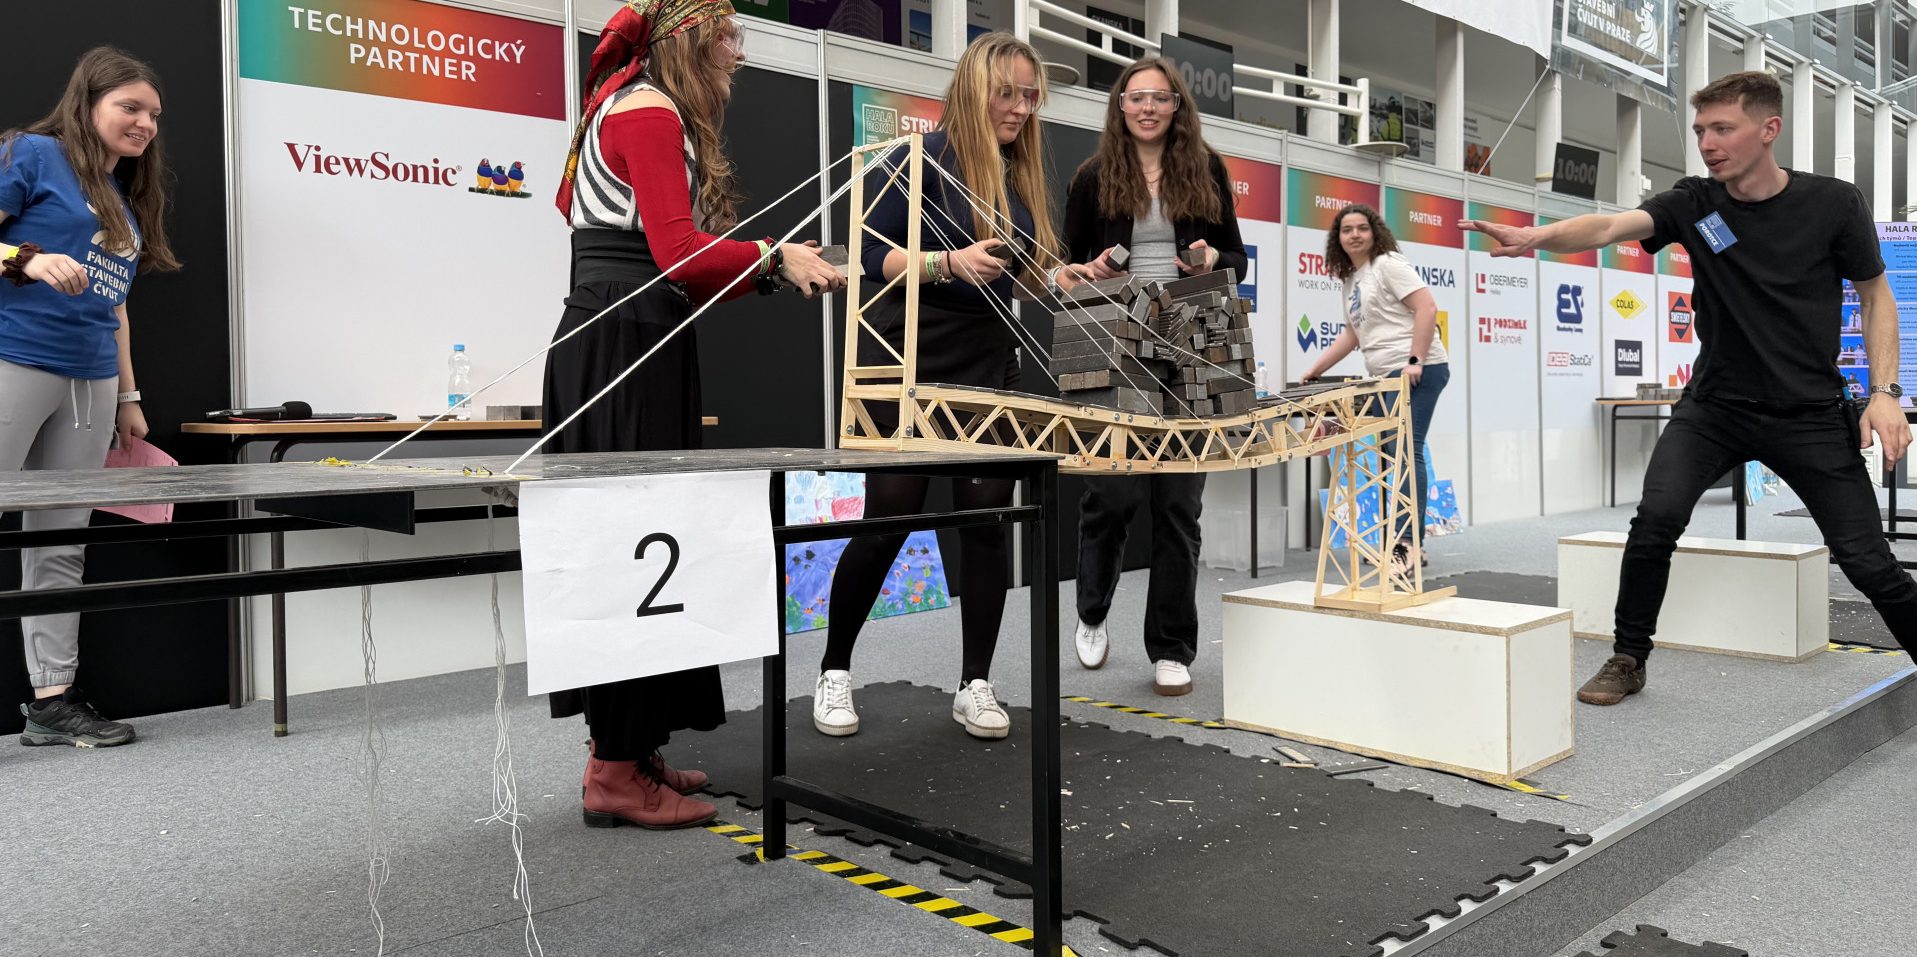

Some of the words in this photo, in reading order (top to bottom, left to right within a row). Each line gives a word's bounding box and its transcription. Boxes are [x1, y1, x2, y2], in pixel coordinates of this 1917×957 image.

[1577, 0, 1616, 19] AVEBNÍ
[1577, 5, 1598, 28] ČVUT
[1606, 20, 1631, 42] PRAZE
[288, 6, 526, 64] TECHNOLOGICKÝ
[350, 43, 477, 82] PARTNER
[865, 108, 894, 124] HALA
[866, 121, 895, 135] ROKU
[1555, 157, 1597, 186] 10:00
[1409, 211, 1442, 227] PARTNER
[1885, 225, 1910, 233] HALA
[1616, 244, 1640, 258] PARTNER
[87, 250, 129, 281] FAKULTA
[93, 280, 119, 303] ČVUT
[1297, 279, 1319, 290] WORK
[1617, 348, 1640, 363] Dlubal
[634, 532, 684, 618] 2
